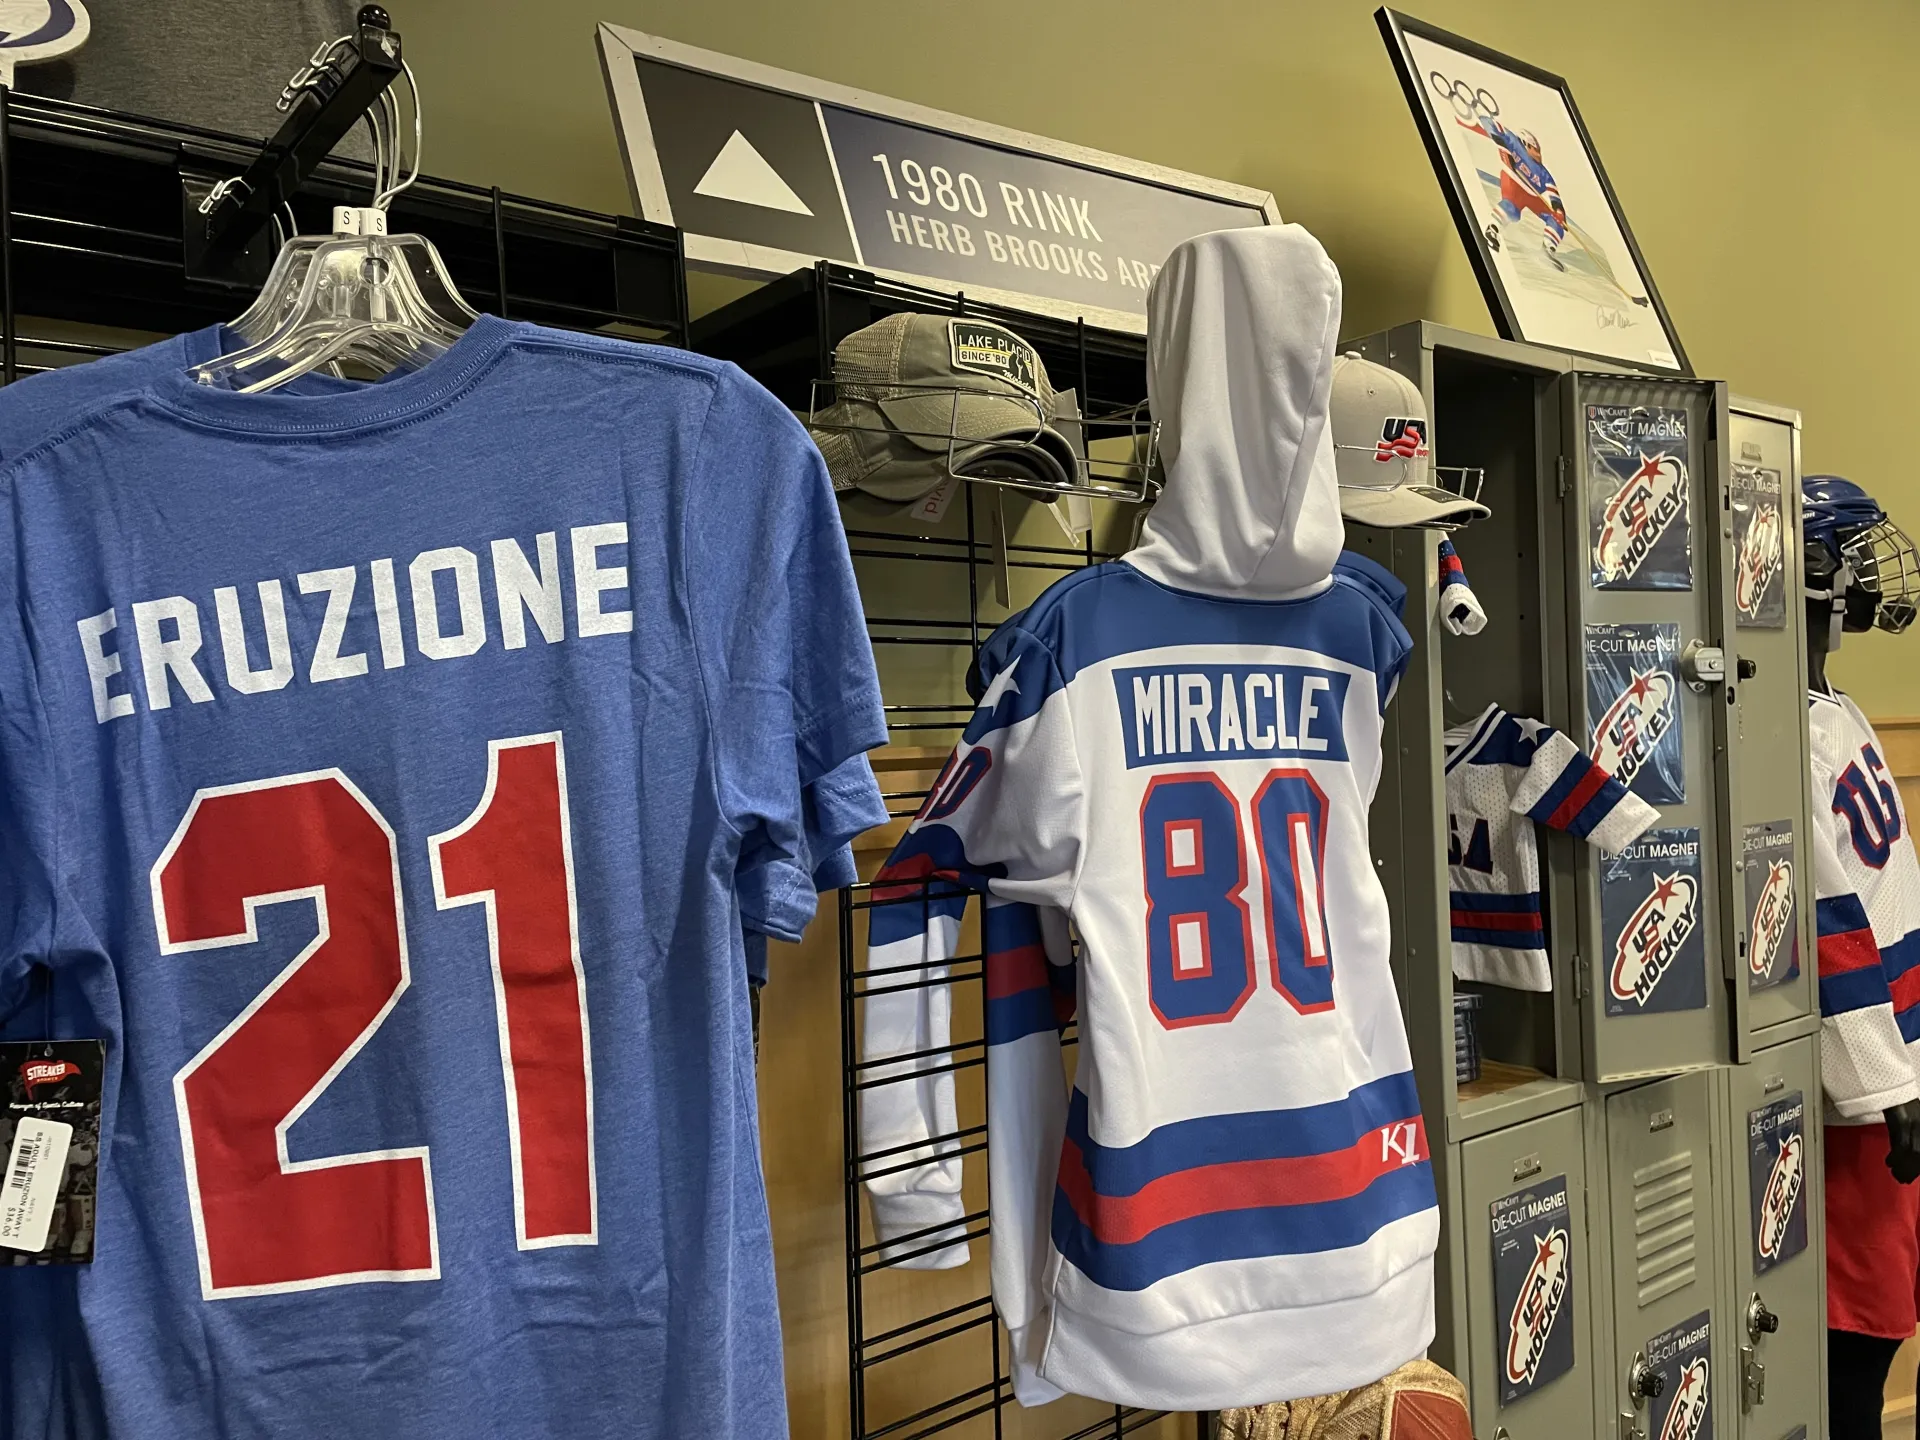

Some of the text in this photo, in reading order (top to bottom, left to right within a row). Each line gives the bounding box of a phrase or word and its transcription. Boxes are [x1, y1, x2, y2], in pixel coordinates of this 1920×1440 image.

[343, 211, 350, 225] S
[871, 153, 1102, 242] 1980 RINK
[376, 218, 383, 232] S
[886, 208, 976, 257] HERB
[985, 228, 1109, 282] BROOKS
[959, 334, 1031, 361] LAKE PLACID
[961, 350, 990, 361] SINCE
[1637, 422, 1685, 438] MAGNET
[1619, 484, 1653, 538] USA
[1621, 484, 1682, 573] HOCKEY
[76, 522, 633, 724] ERUZIONE
[1586, 639, 1676, 653] IE-CUT MAGNET
[1133, 672, 1330, 757] MIRACLE
[1650, 842, 1698, 858] MAGNET
[1766, 832, 1792, 847] MAGNET
[1140, 767, 1336, 1030] 80
[1632, 908, 1666, 964] USA
[1633, 903, 1692, 1001] HOCKEY
[1762, 887, 1793, 977] HOCKEY
[150, 730, 598, 1300] 21
[27, 1064, 65, 1081] STREAKER
[1751, 1104, 1802, 1136] DIE-CUT MAGNET
[28, 1143, 40, 1170] ADULT
[19, 1171, 33, 1206] ERUZION
[1771, 1161, 1801, 1252] HOCKEY
[13, 1207, 24, 1231] AWAY
[1492, 1207, 1527, 1234] DIE-CUT
[1528, 1190, 1567, 1218] MAGNET
[1523, 1274, 1546, 1335] USA
[1525, 1260, 1565, 1378] HOCKEY
[1649, 1324, 1709, 1368] DIE-CUT MAGNET
